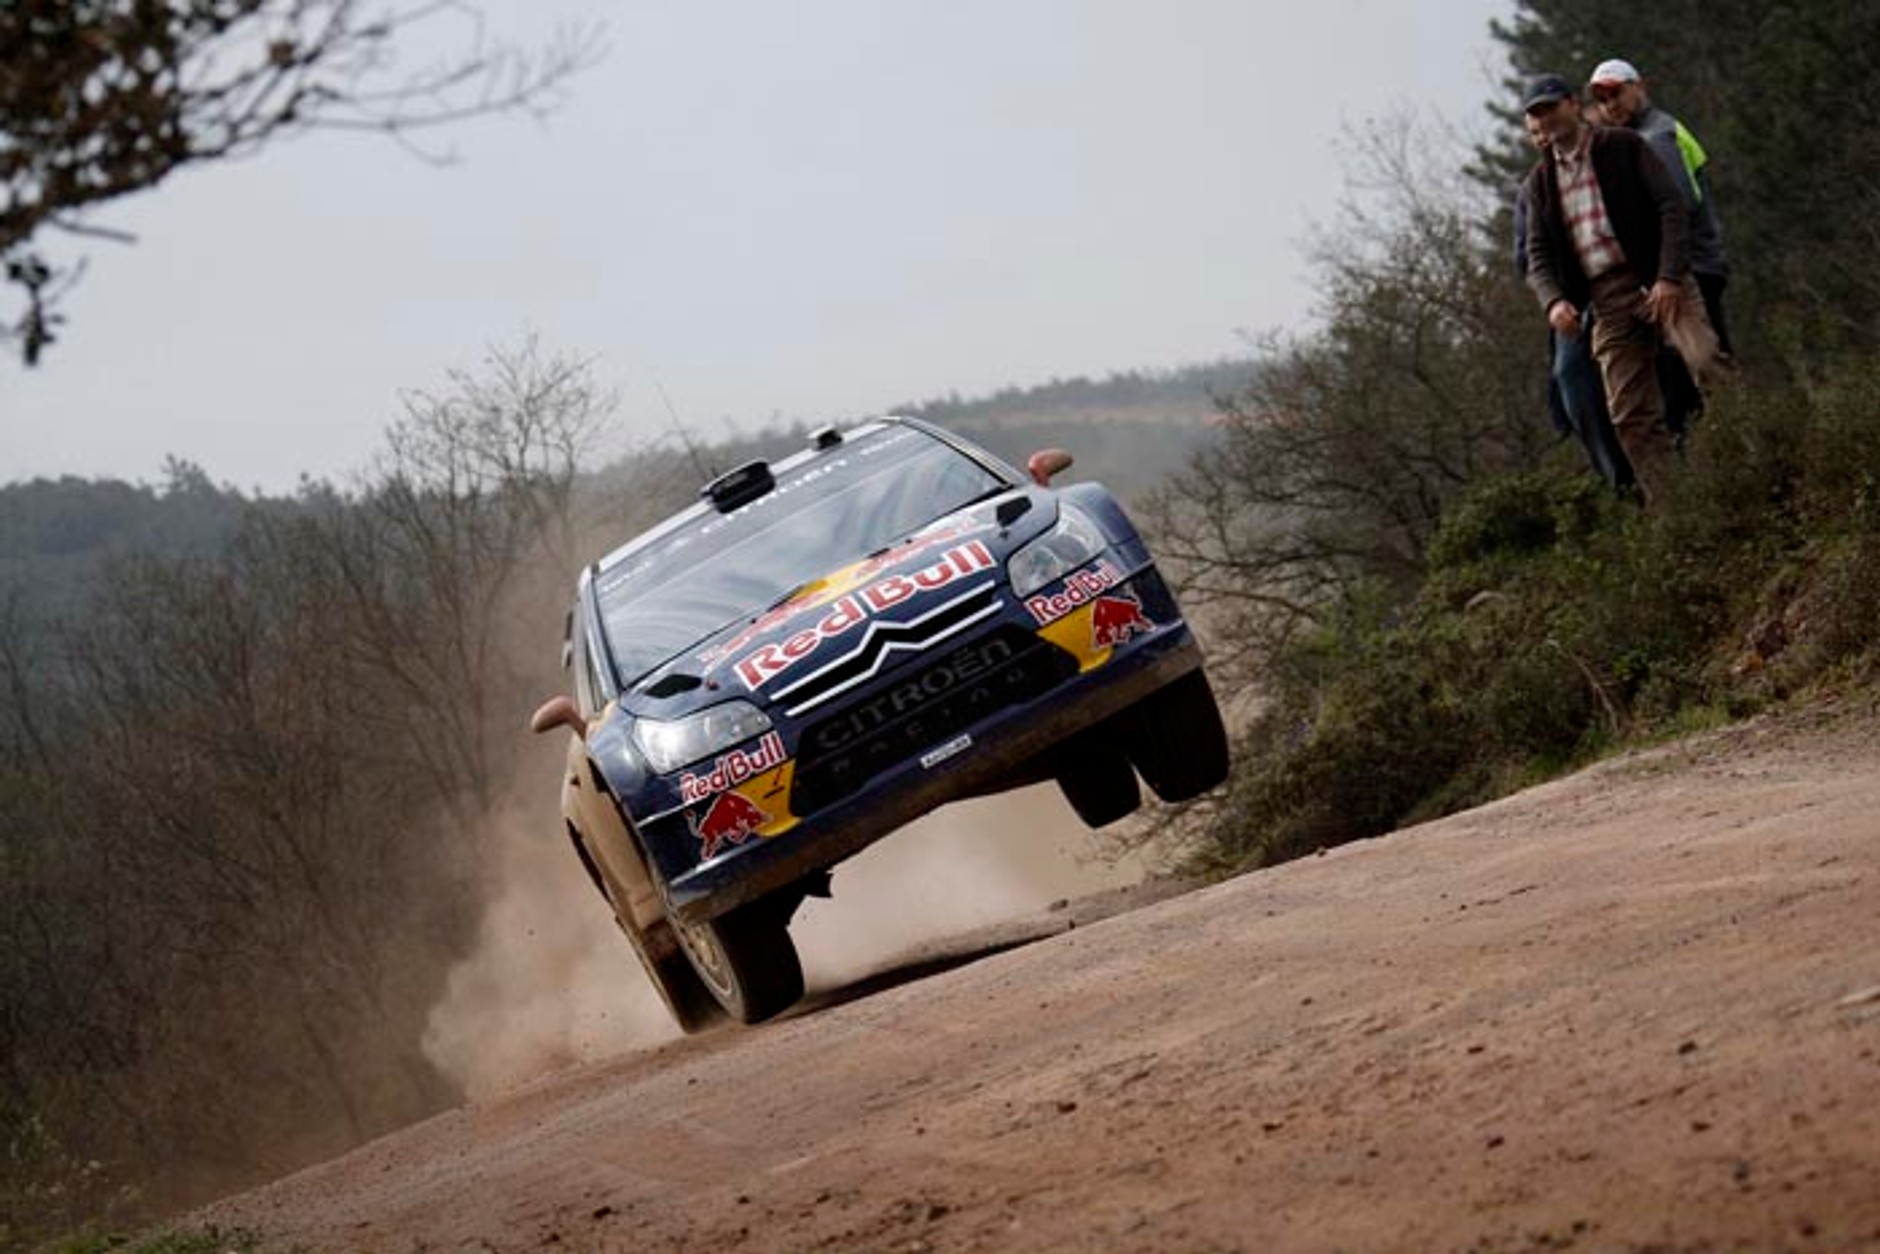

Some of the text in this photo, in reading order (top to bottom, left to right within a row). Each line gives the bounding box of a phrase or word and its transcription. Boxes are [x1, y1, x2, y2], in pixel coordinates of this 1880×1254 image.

[733, 540, 998, 693] Red Bull
[1024, 576, 1086, 627] Red
[680, 730, 788, 804] Red Bull
